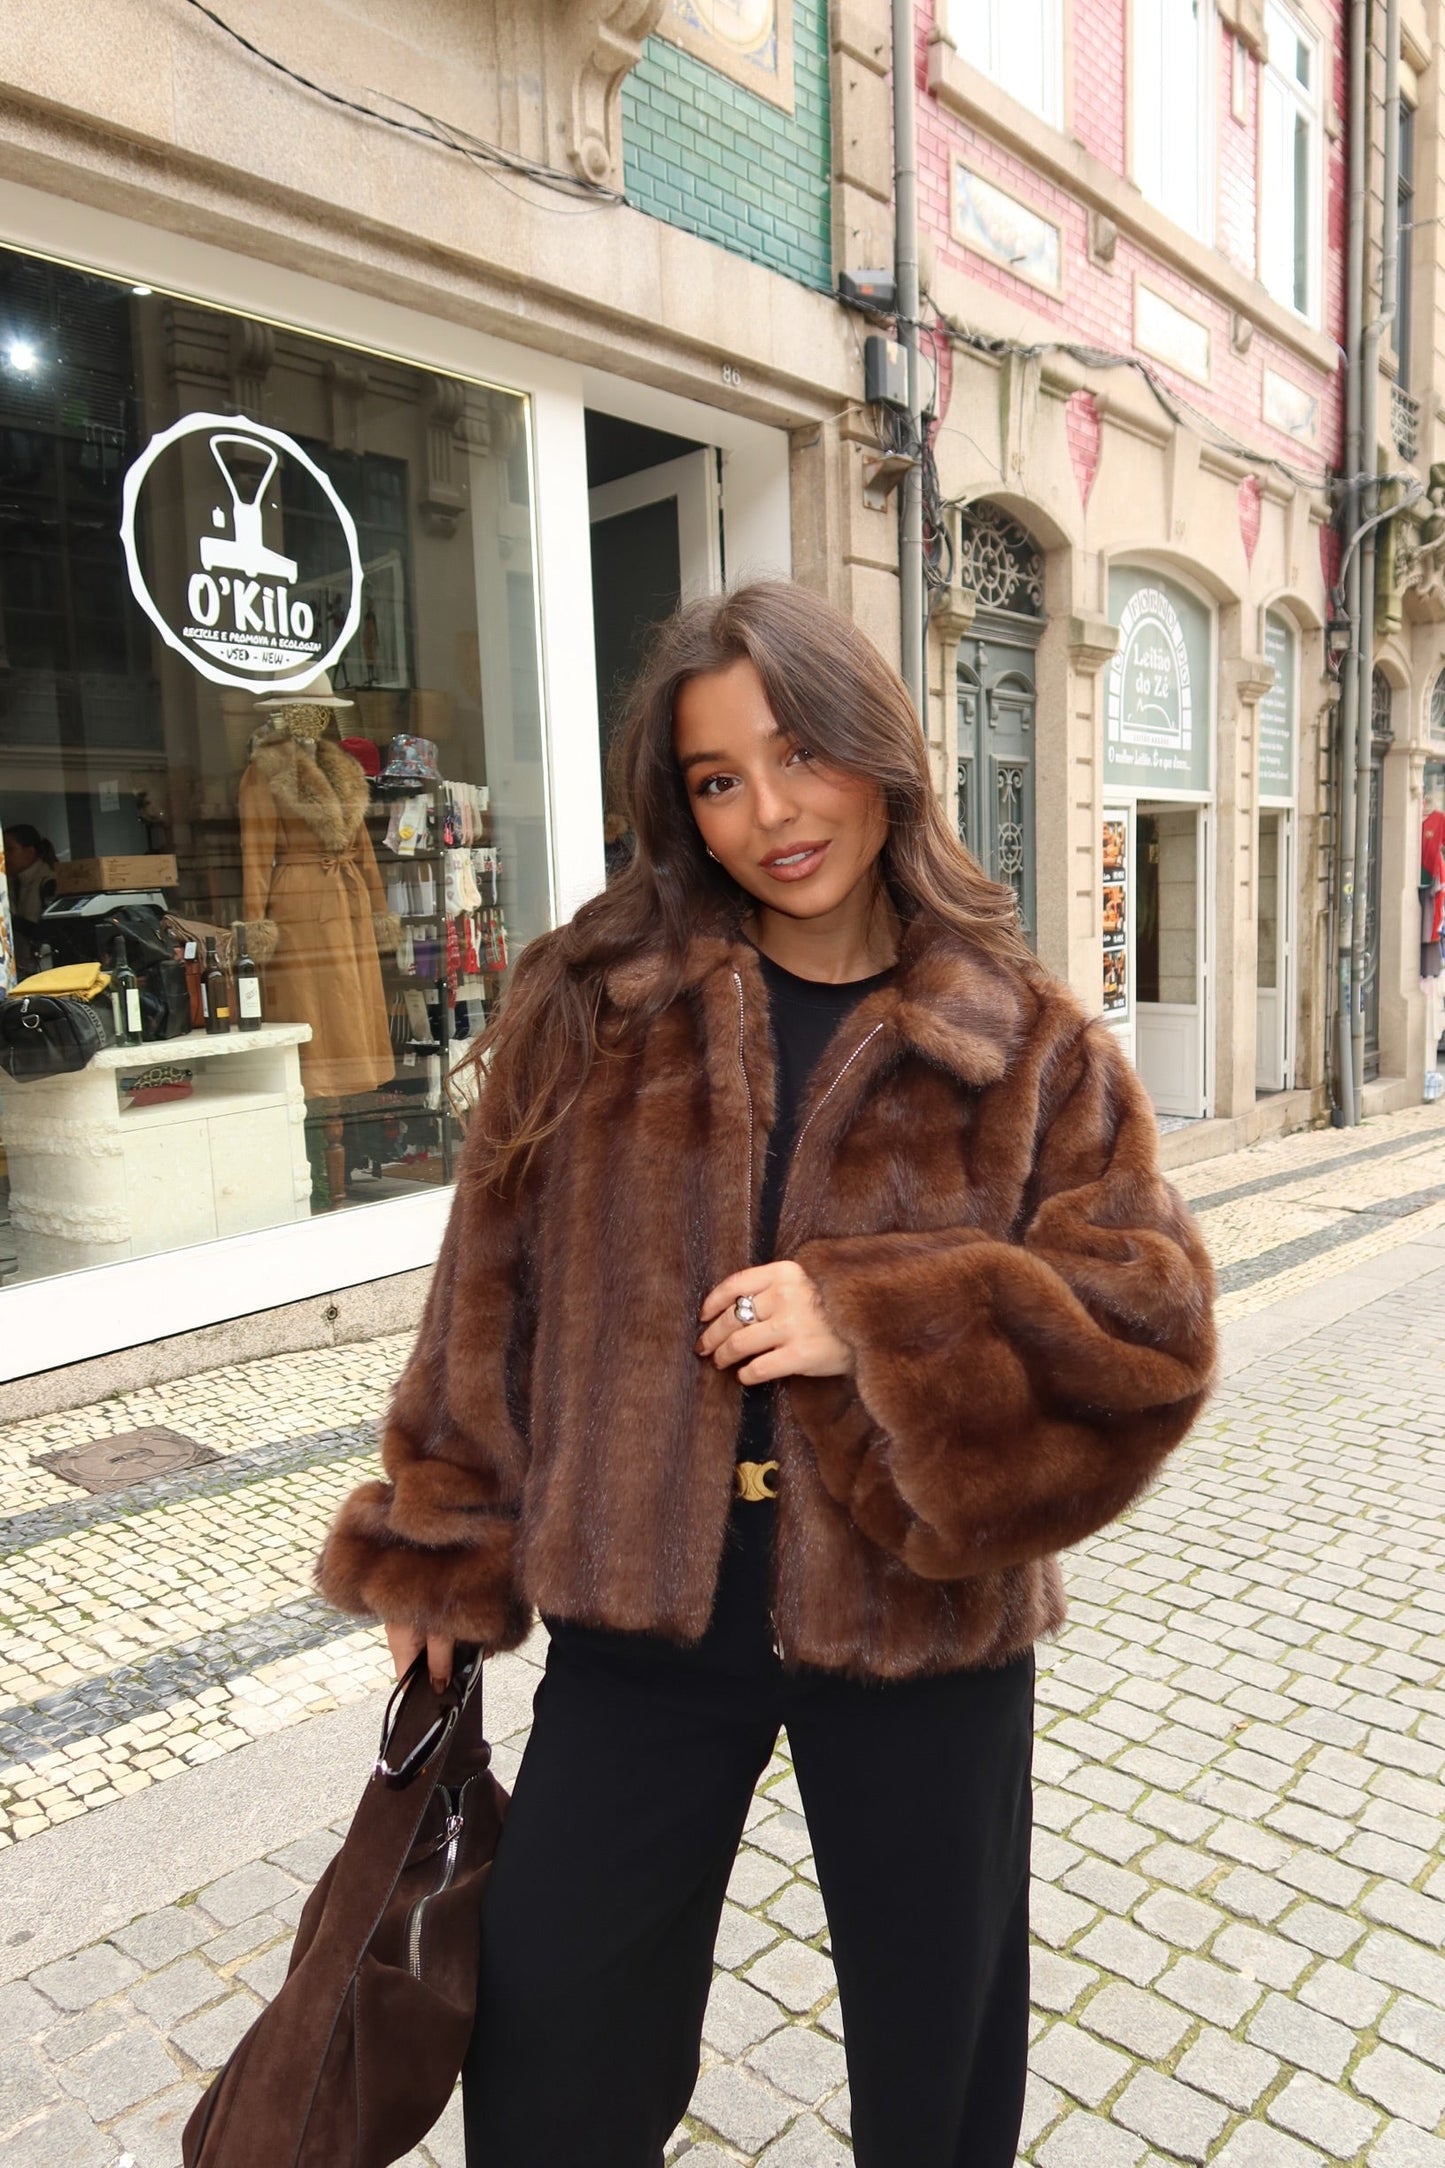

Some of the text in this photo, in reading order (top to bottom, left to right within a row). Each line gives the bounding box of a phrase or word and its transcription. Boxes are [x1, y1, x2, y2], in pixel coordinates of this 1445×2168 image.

[723, 363, 741, 385] 86
[188, 573, 314, 639] O'Kilo
[1131, 592, 1175, 627] FORNO
[183, 627, 219, 640] RECICLE
[221, 631, 228, 641] E
[229, 632, 269, 646] PROMOVA
[270, 637, 277, 647] A
[226, 648, 283, 664] USED NEW
[1133, 643, 1171, 672] Leitão
[1136, 672, 1170, 698] do Zé
